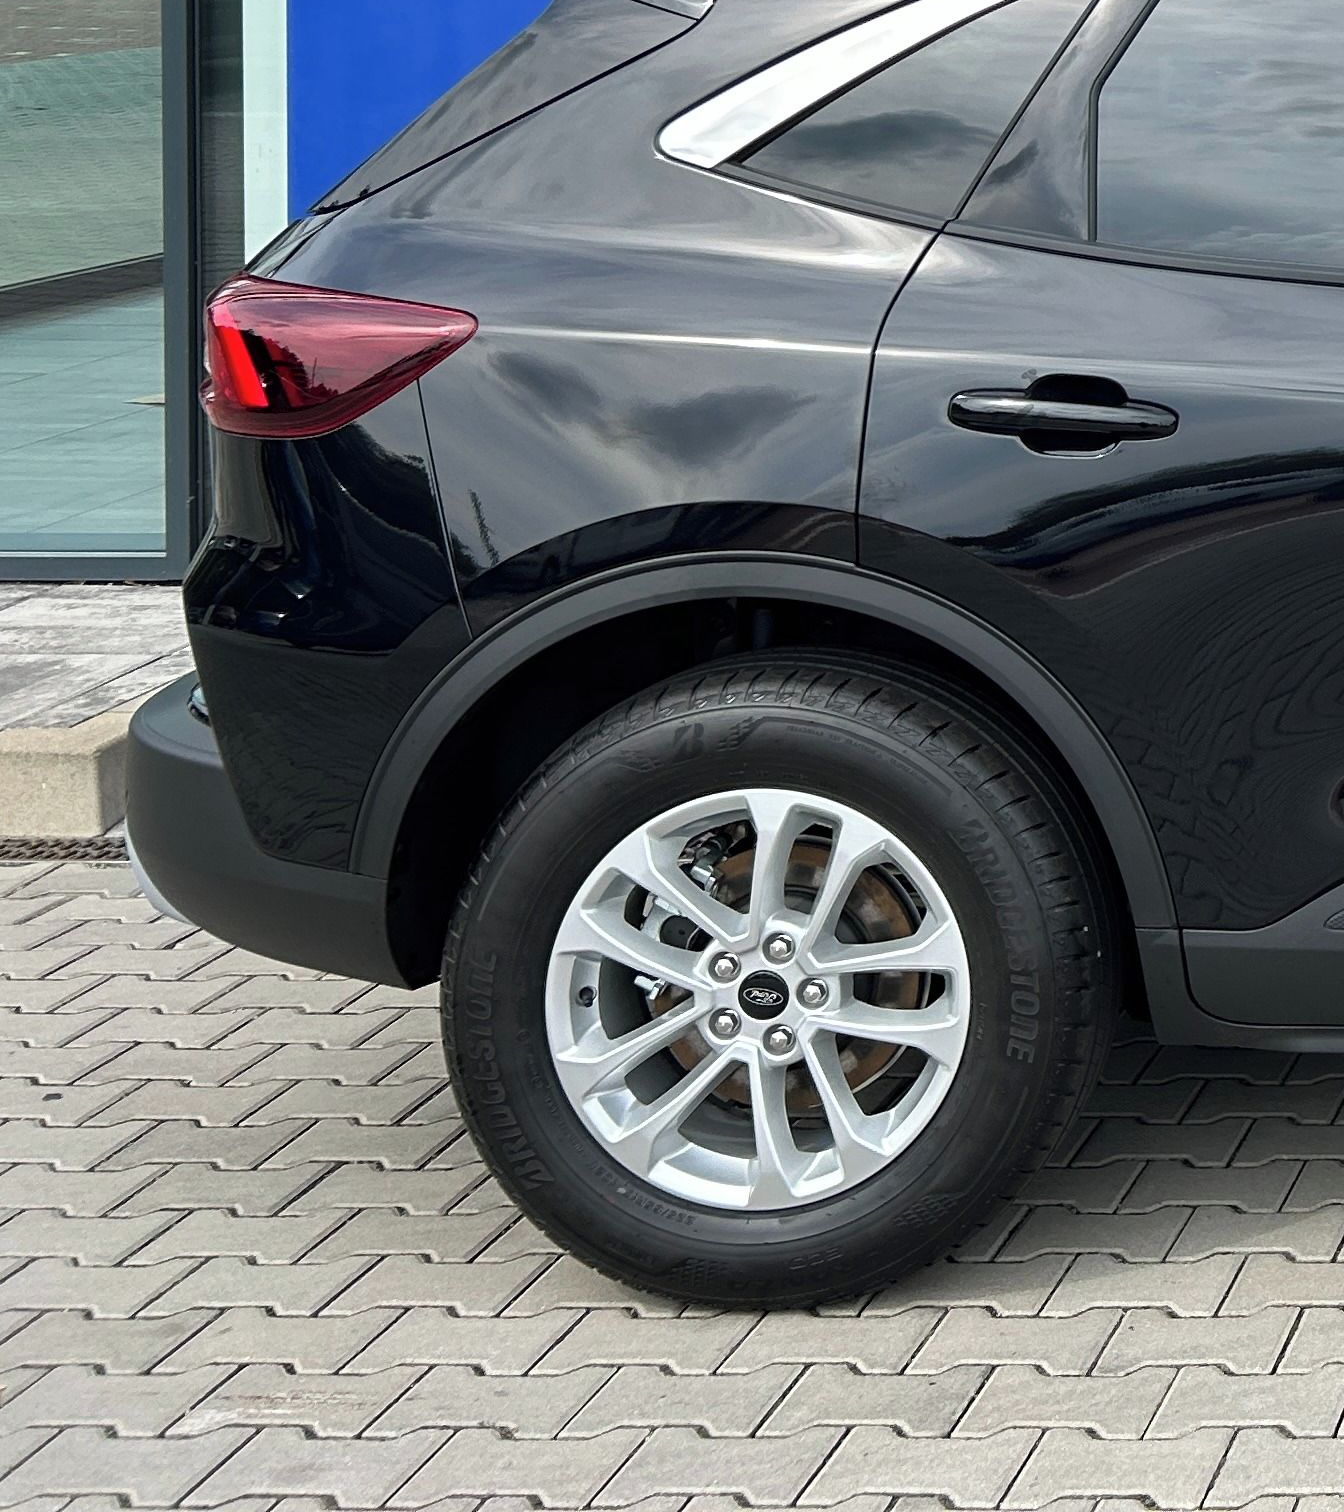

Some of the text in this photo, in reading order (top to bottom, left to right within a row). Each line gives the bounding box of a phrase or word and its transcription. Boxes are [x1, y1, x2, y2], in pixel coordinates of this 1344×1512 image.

[749, 989, 778, 1004] Ford
[950, 817, 1041, 1064] BRIDGESTONE
[465, 952, 555, 1191] BRIDGESTONE
